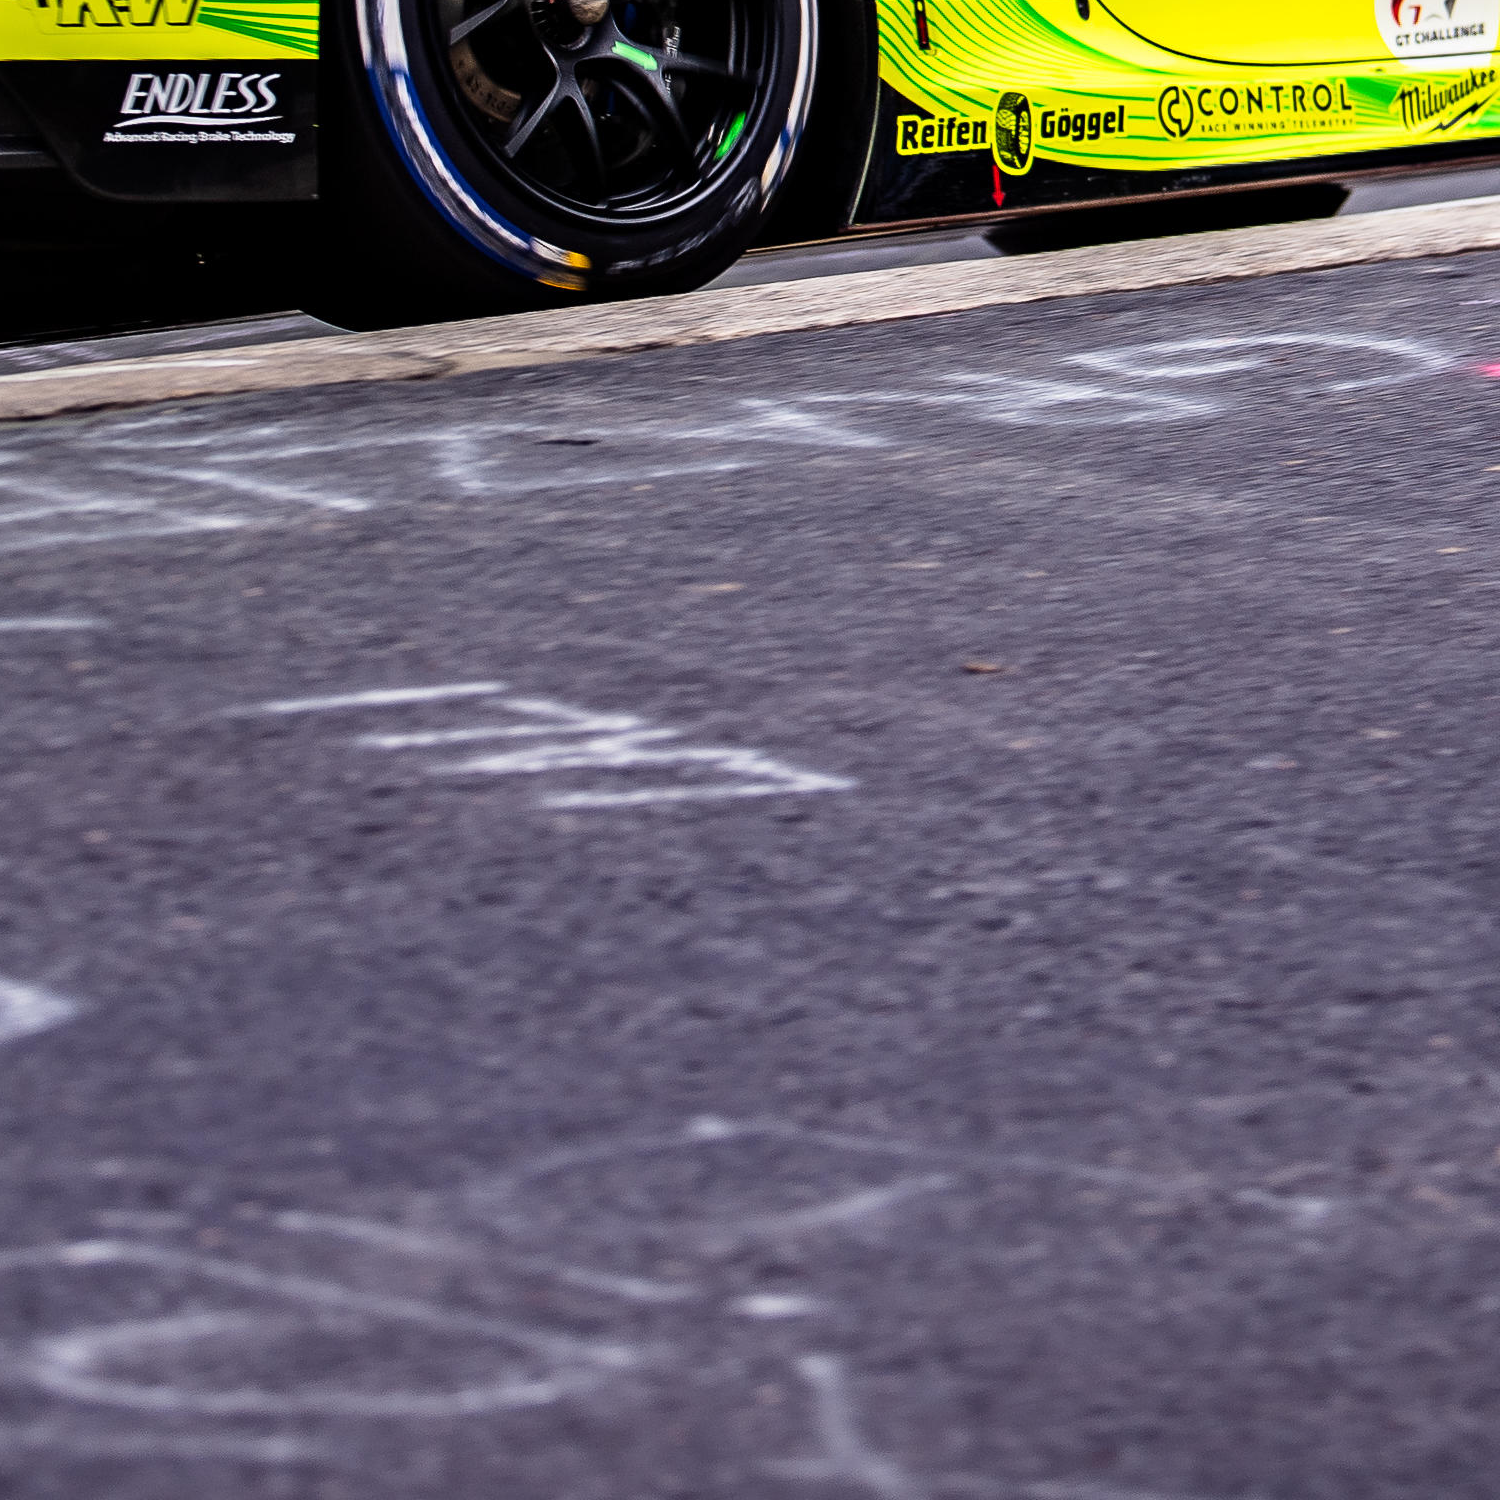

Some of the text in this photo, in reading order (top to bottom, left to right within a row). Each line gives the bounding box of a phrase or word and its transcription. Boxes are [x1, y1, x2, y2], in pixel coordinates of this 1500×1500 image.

[1395, 22, 1485, 47] GT CHALLENGE
[119, 72, 282, 115] ENDLESS
[1197, 83, 1353, 117] CONTROL
[1392, 68, 1497, 132] Milwaukee
[900, 105, 1125, 150] Reifen Göggel
